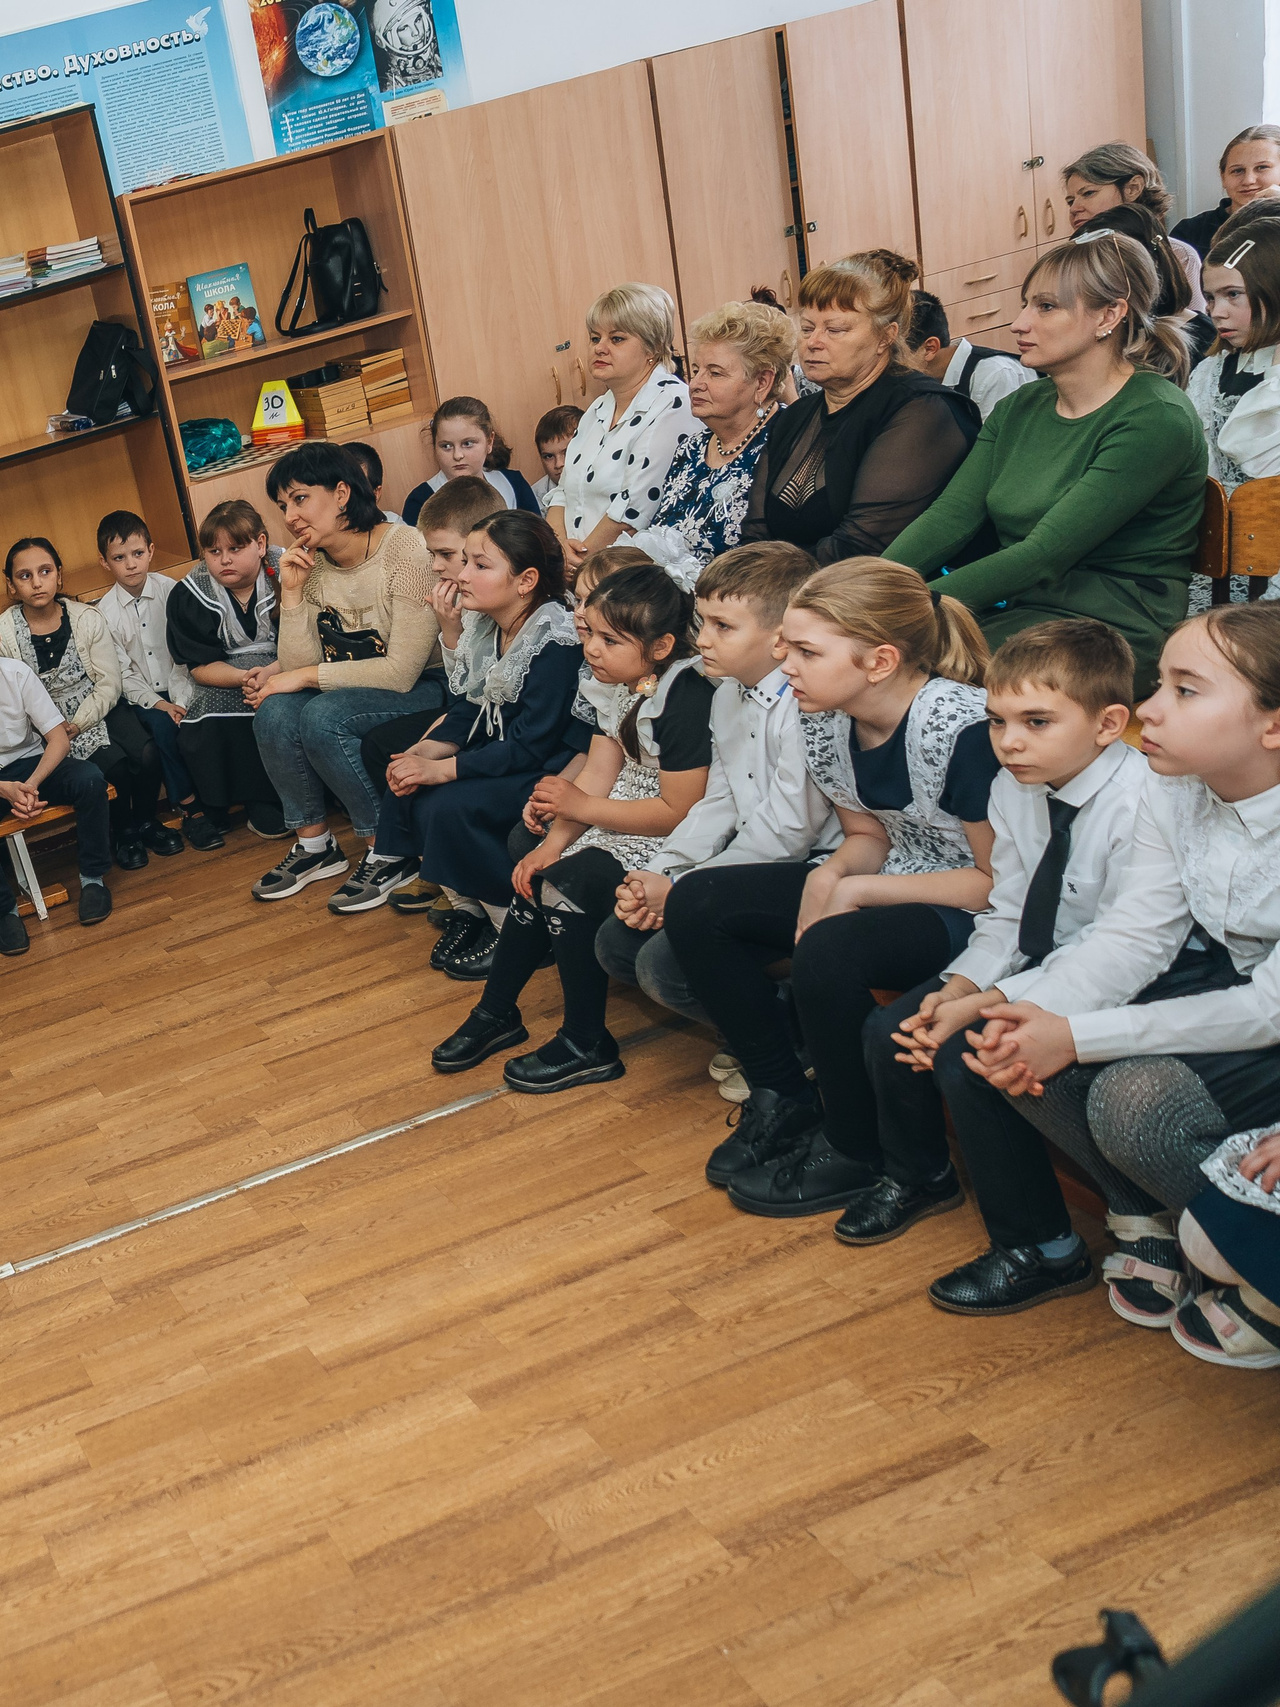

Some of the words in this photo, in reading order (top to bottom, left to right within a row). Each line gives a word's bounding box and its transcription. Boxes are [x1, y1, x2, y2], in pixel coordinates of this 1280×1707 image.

[63, 29, 201, 76] Духовность.
[204, 284, 236, 298] ШКОЛА
[152, 302, 175, 312] КОЛА
